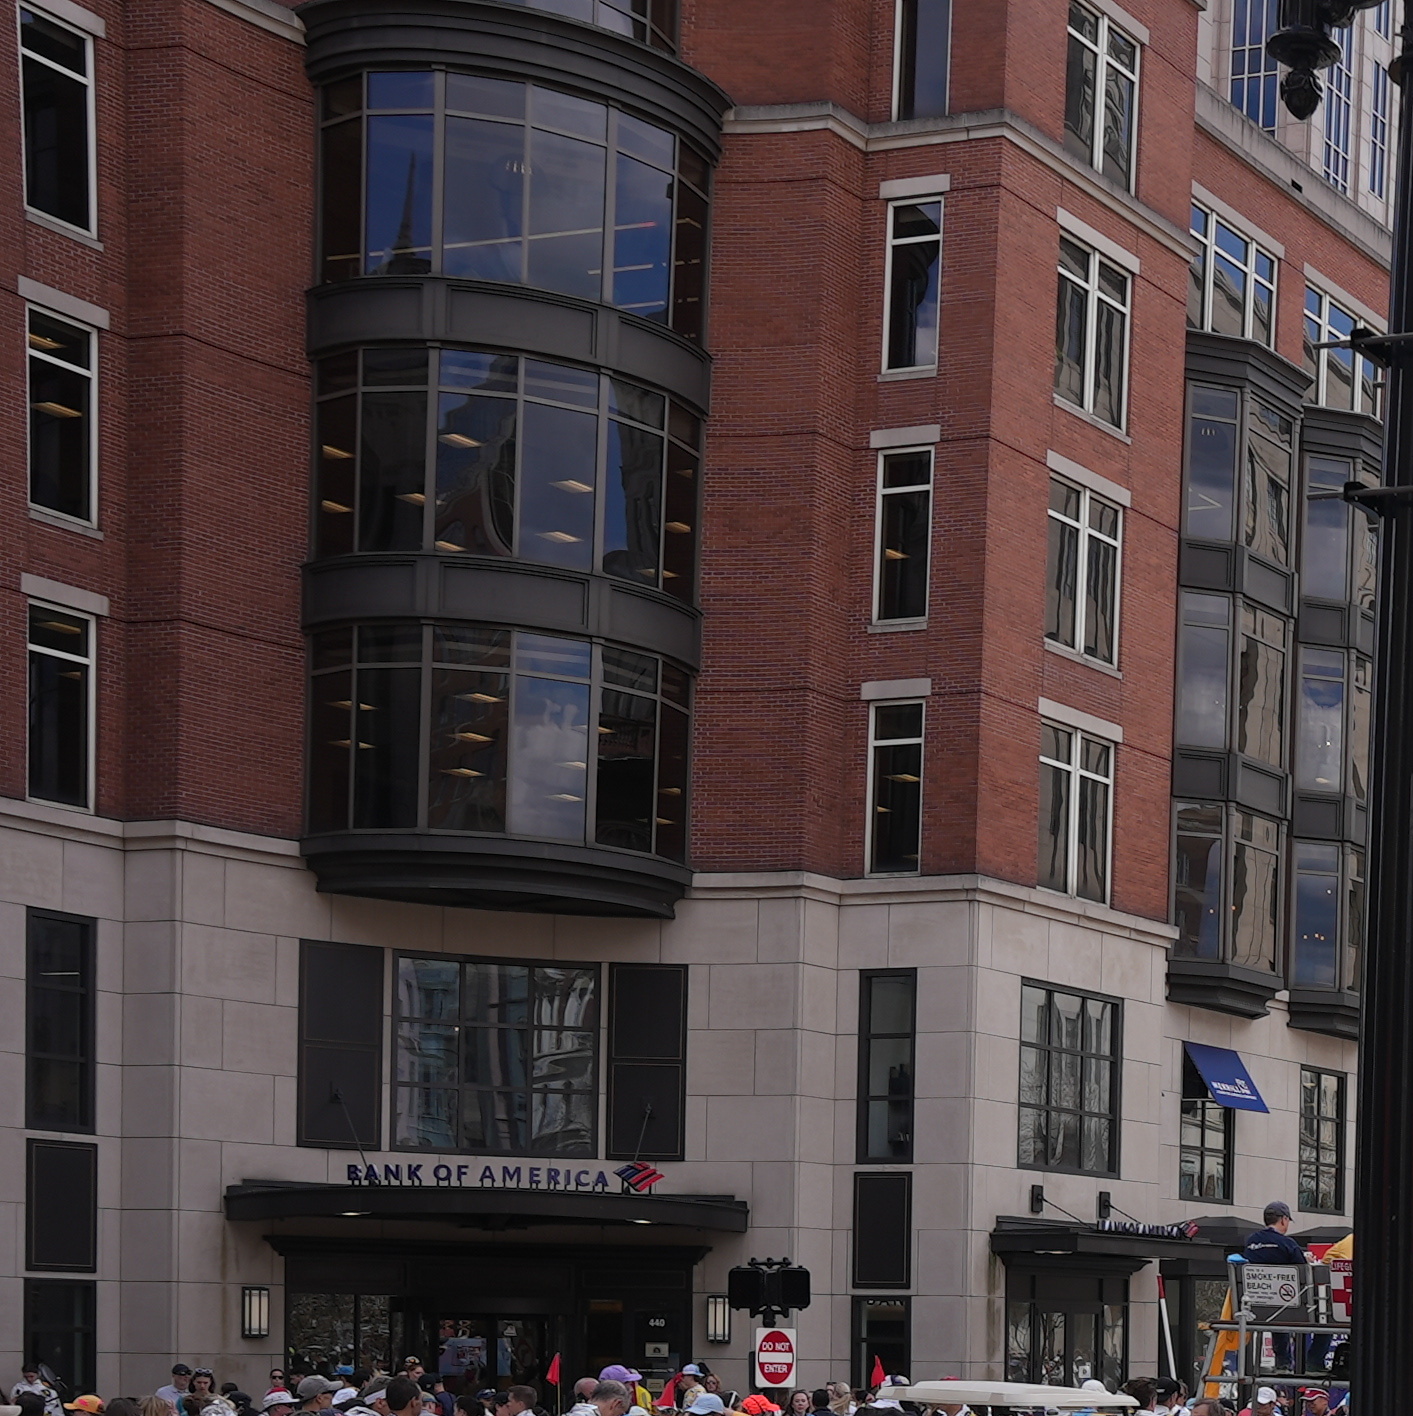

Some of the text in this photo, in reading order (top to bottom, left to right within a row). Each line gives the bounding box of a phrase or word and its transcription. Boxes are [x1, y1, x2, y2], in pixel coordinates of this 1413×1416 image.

[346, 1164, 609, 1188] BANK OF AMERICA
[648, 1318, 666, 1328] 440
[762, 1341, 790, 1352] DO NOT
[764, 1364, 788, 1374] ENTER
